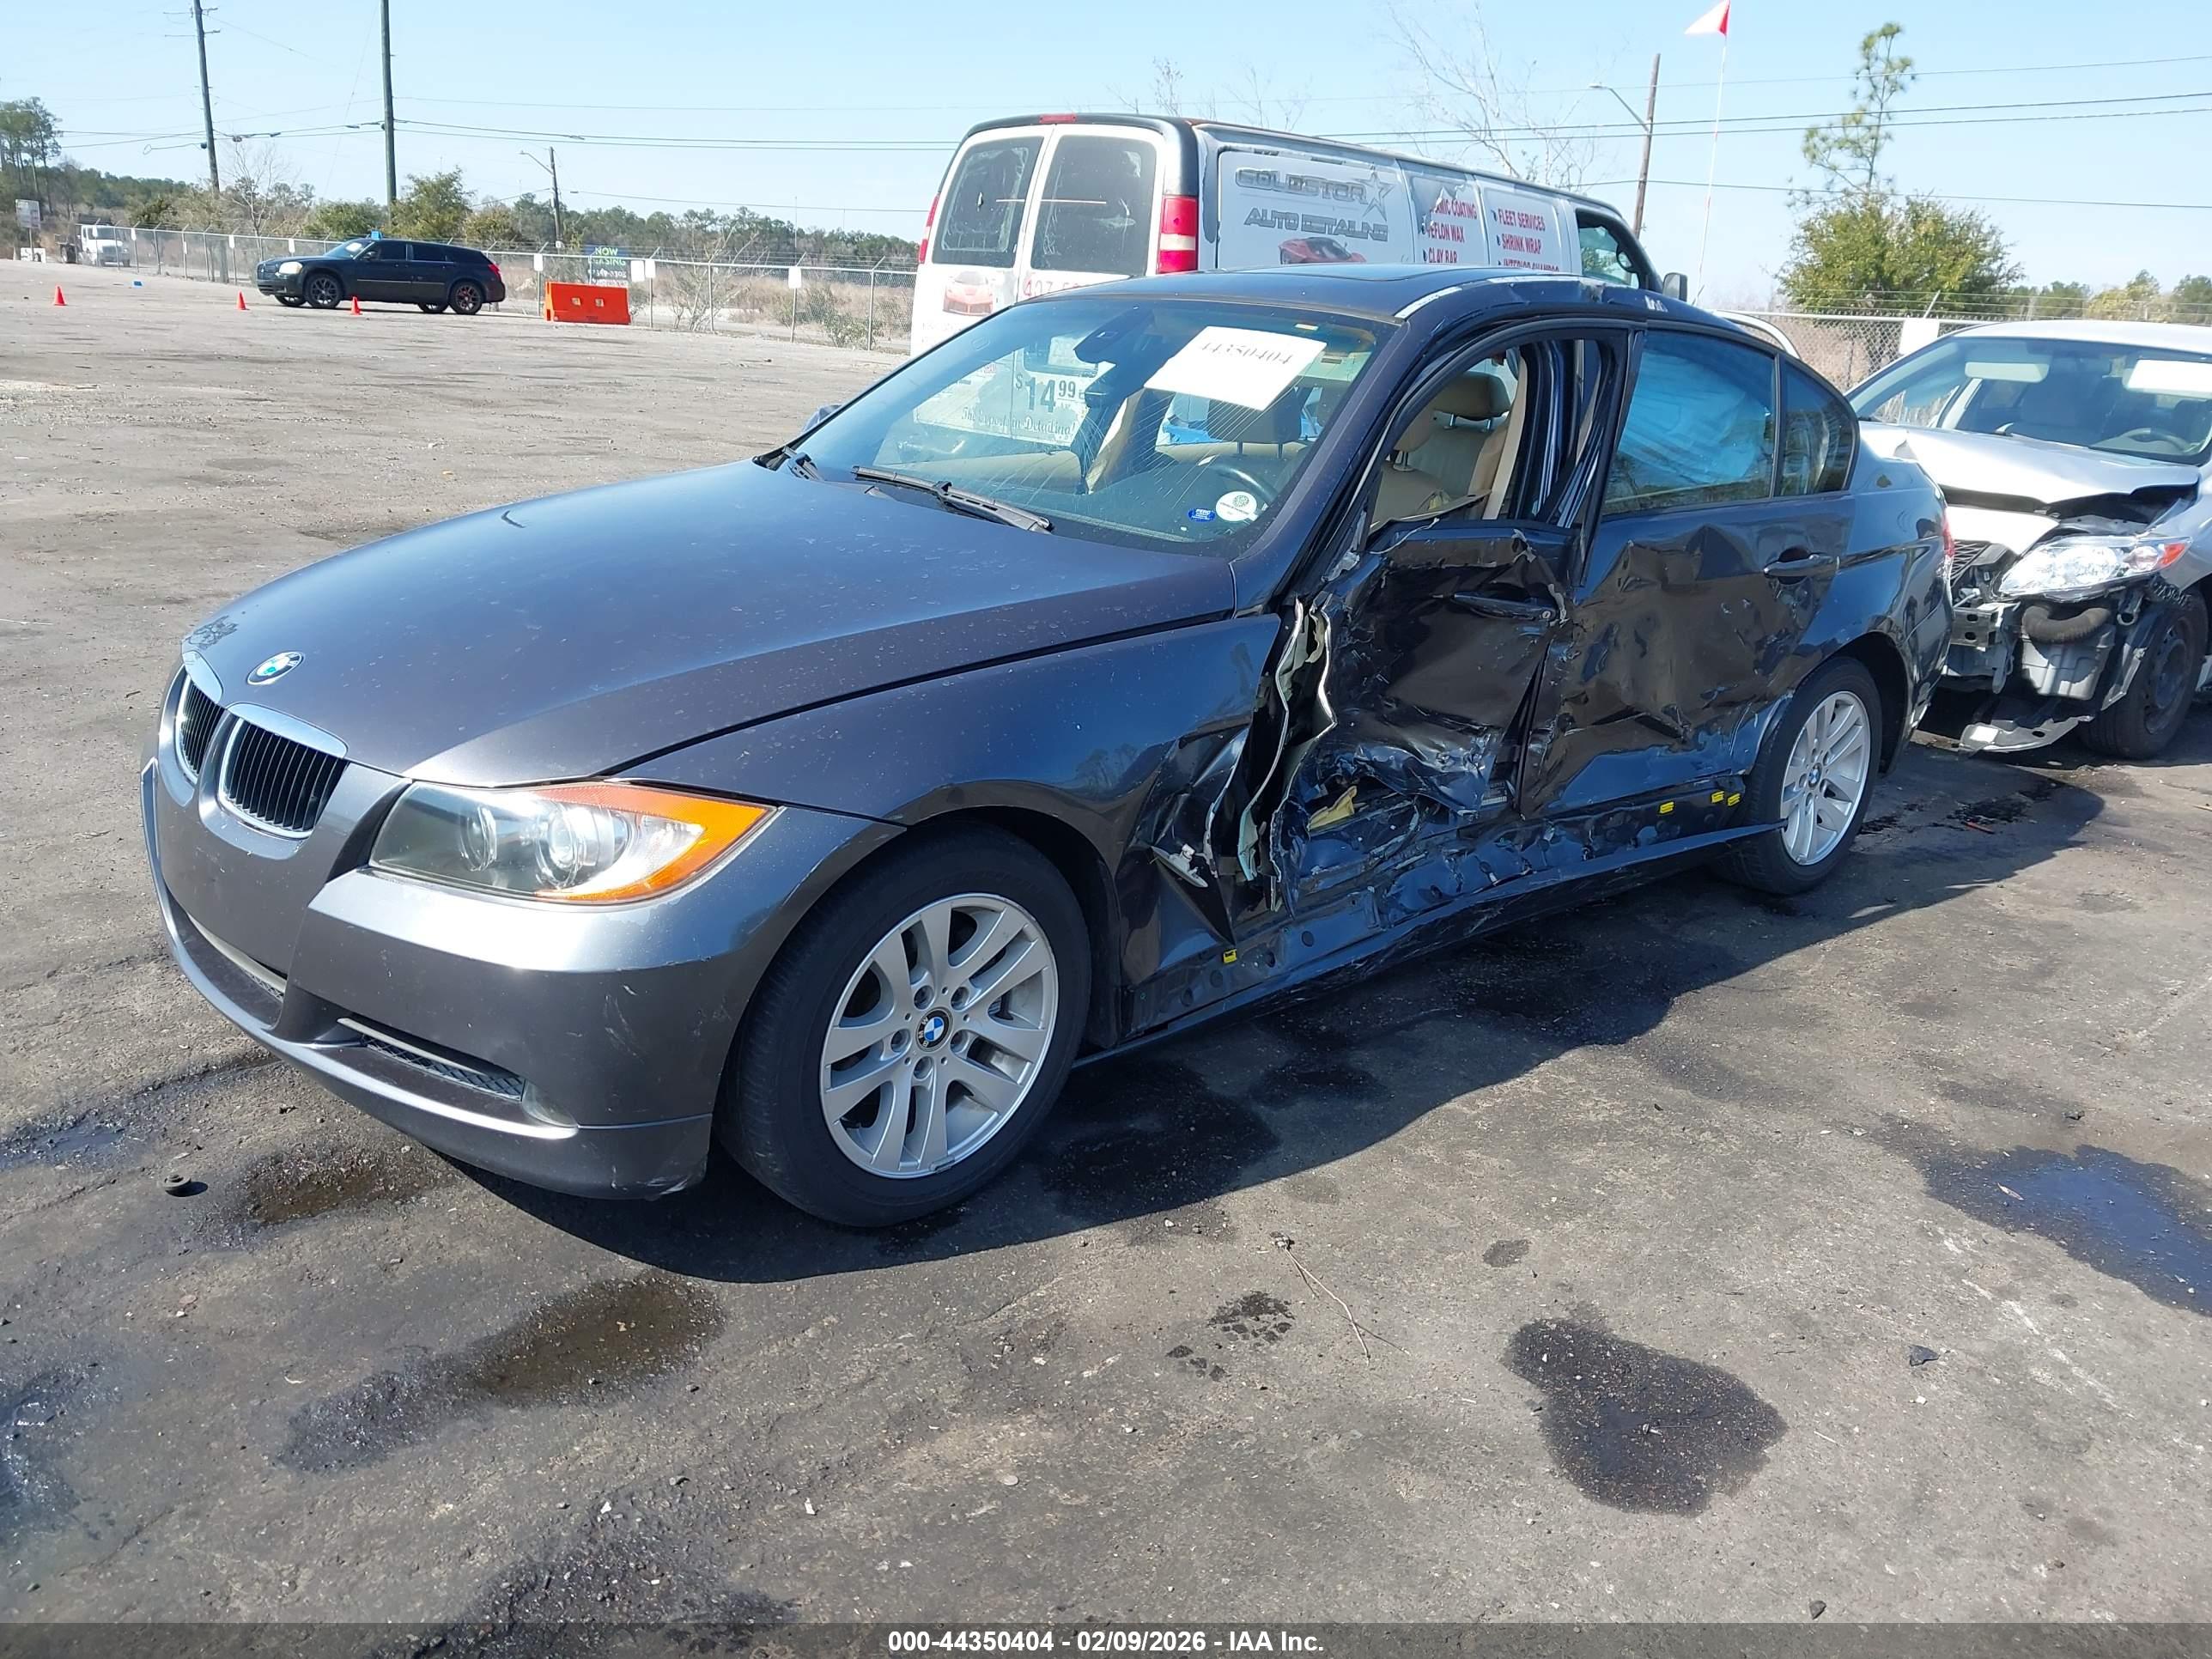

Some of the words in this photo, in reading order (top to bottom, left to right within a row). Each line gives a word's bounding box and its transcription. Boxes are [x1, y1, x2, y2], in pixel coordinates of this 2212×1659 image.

[1451, 200, 1478, 220] COATING
[1498, 208, 1516, 227] FLEET
[1517, 210, 1546, 232] SERVICES
[1243, 208, 1300, 231] AUTO
[1301, 214, 1389, 242] DETAILING
[1449, 225, 1465, 244] WAX
[595, 246, 618, 256] NOW
[1502, 234, 1524, 252] SHRINK
[1525, 237, 1542, 255] WRAP
[1428, 246, 1443, 264] CLAY
